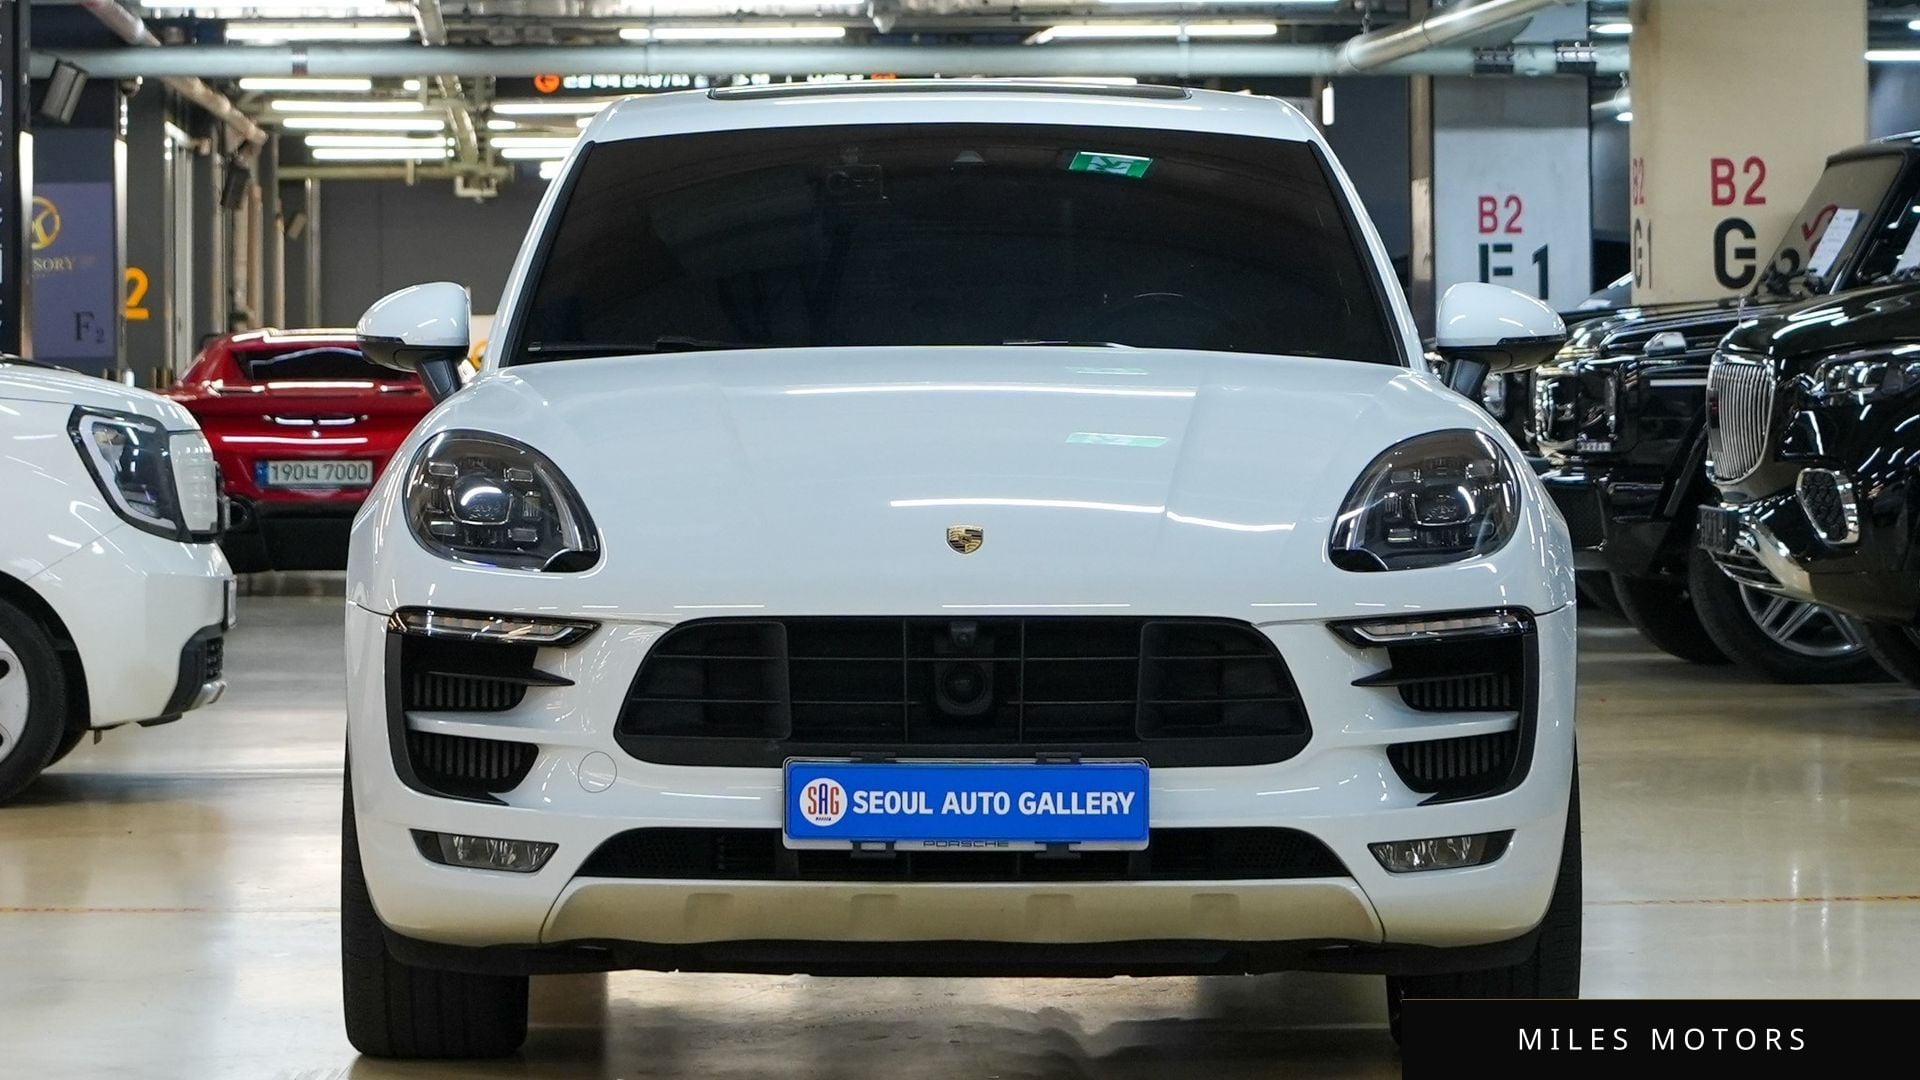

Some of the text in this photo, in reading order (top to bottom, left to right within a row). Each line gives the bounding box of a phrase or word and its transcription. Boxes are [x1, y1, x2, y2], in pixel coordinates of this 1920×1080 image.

[1633, 158, 1645, 206] B2
[1711, 156, 1766, 206] B2
[1479, 195, 1522, 233] B2
[322, 463, 368, 480] 7000
[807, 783, 840, 815] SAG
[852, 790, 1135, 815] SEOUL AUTO GALLERY
[923, 840, 1009, 848] PORSCHE
